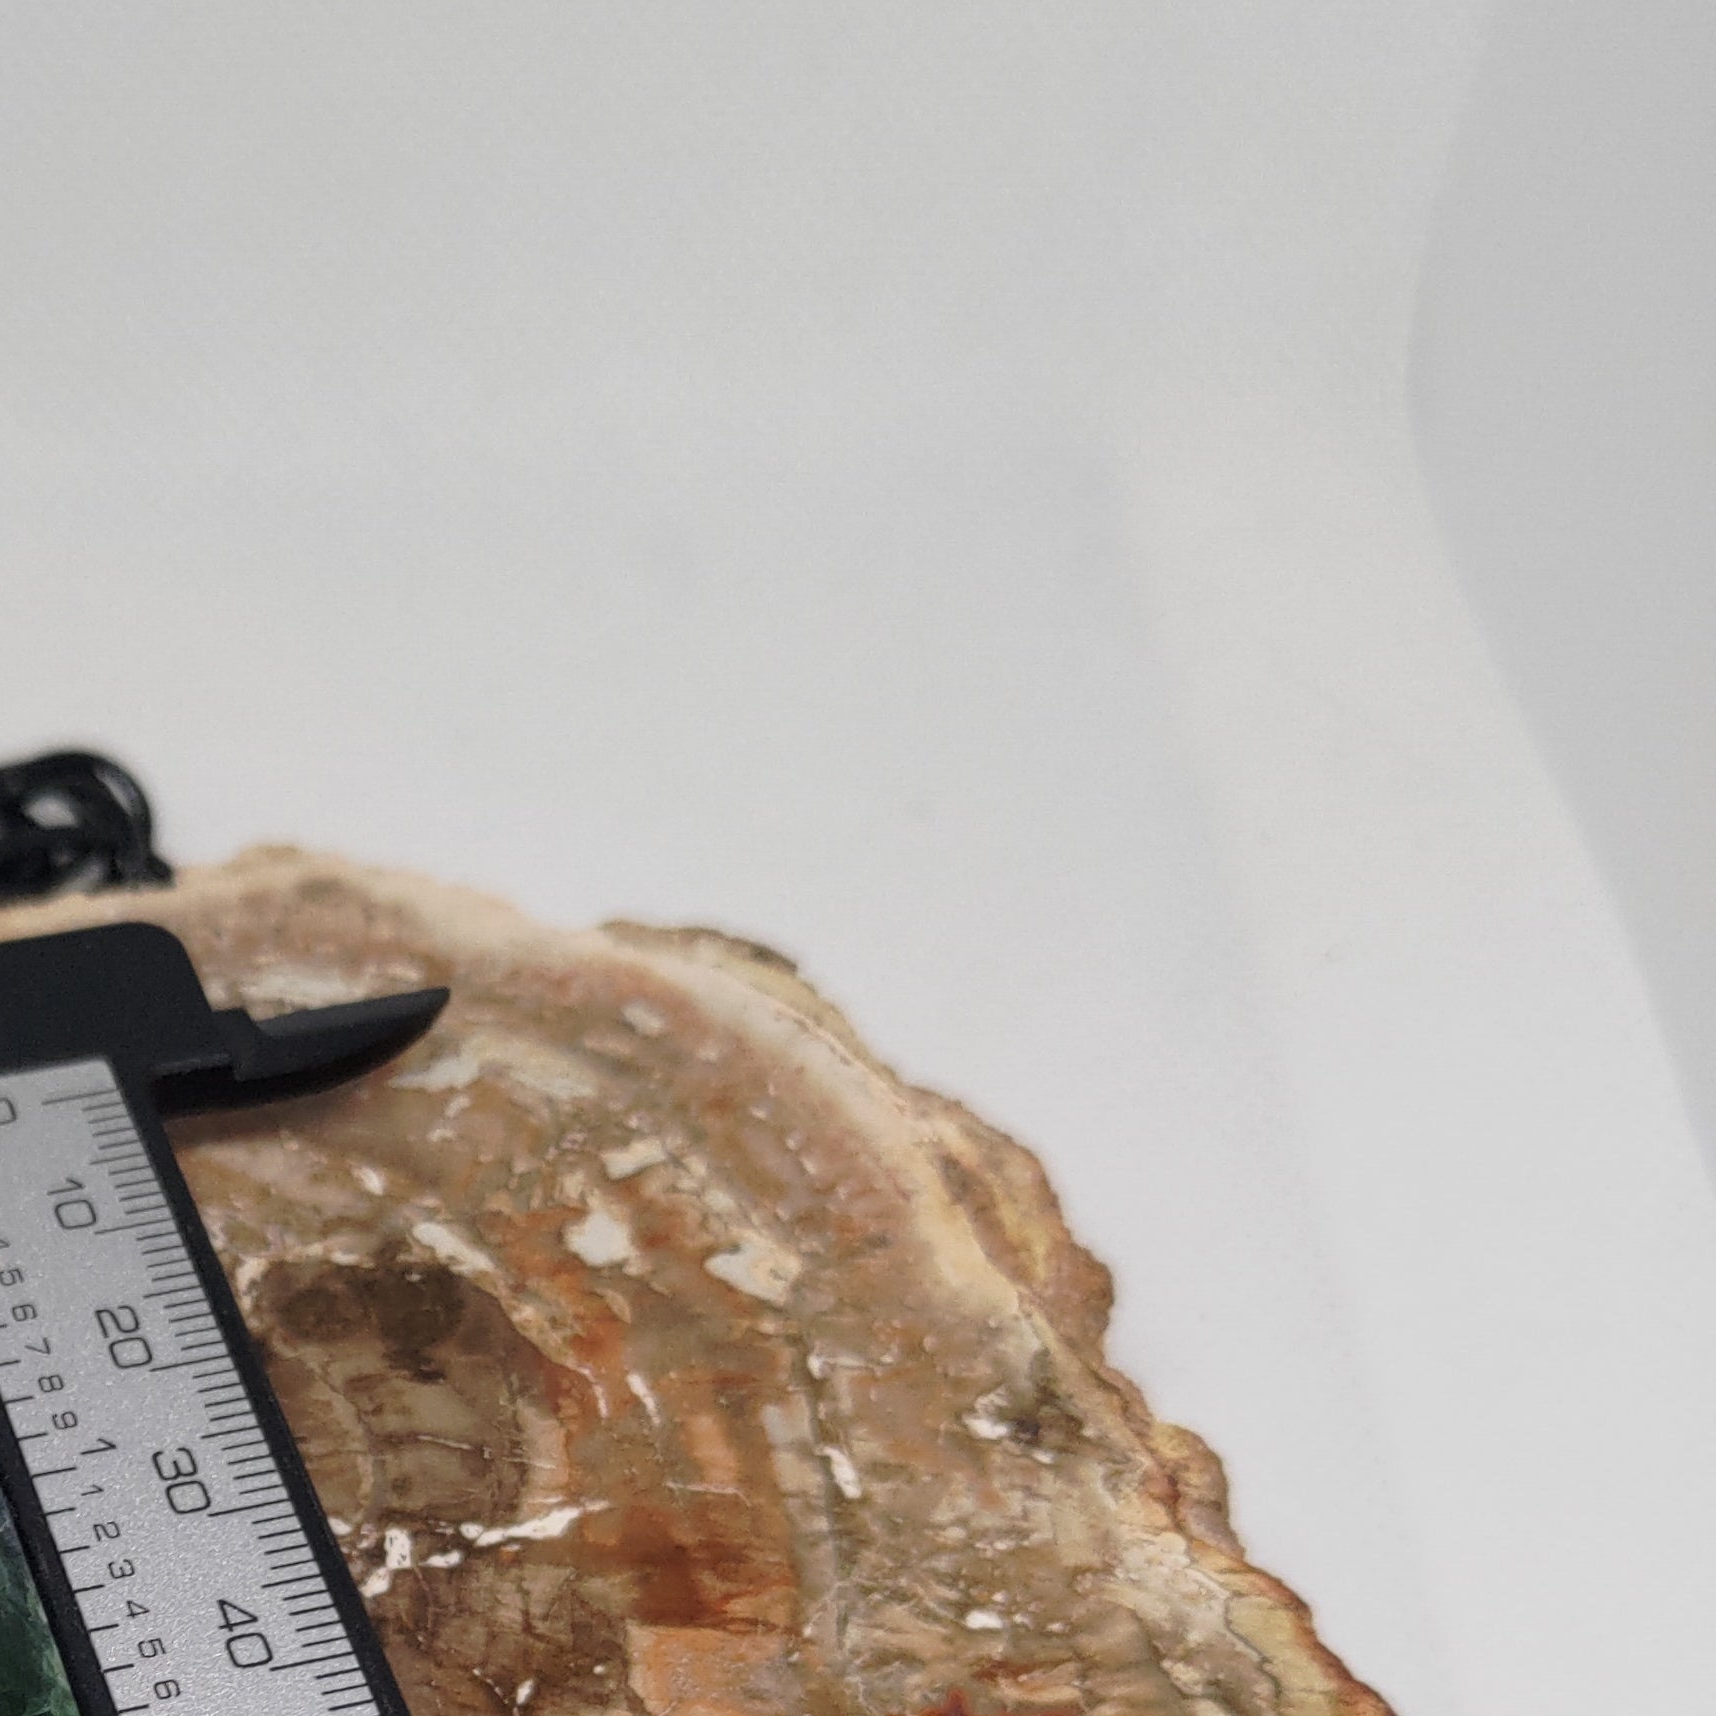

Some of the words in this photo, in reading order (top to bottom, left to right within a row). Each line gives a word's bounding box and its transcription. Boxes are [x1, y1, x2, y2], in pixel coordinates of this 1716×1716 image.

[12, 1303, 37, 1322] 6
[25, 1338, 51, 1356] 7
[38, 1375, 64, 1392] 8
[47, 1176, 96, 1230] 10
[94, 1305, 152, 1369] 20
[152, 1447, 210, 1514] 30
[216, 1600, 273, 1669] 40
[52, 1411, 78, 1429] 9
[81, 1438, 116, 1455] 1
[81, 1484, 103, 1496] 1
[93, 1522, 121, 1542] 2
[108, 1559, 135, 1579] 3
[125, 1600, 150, 1618] 4
[138, 1638, 166, 1658] 5
[154, 1680, 181, 1700] 6
